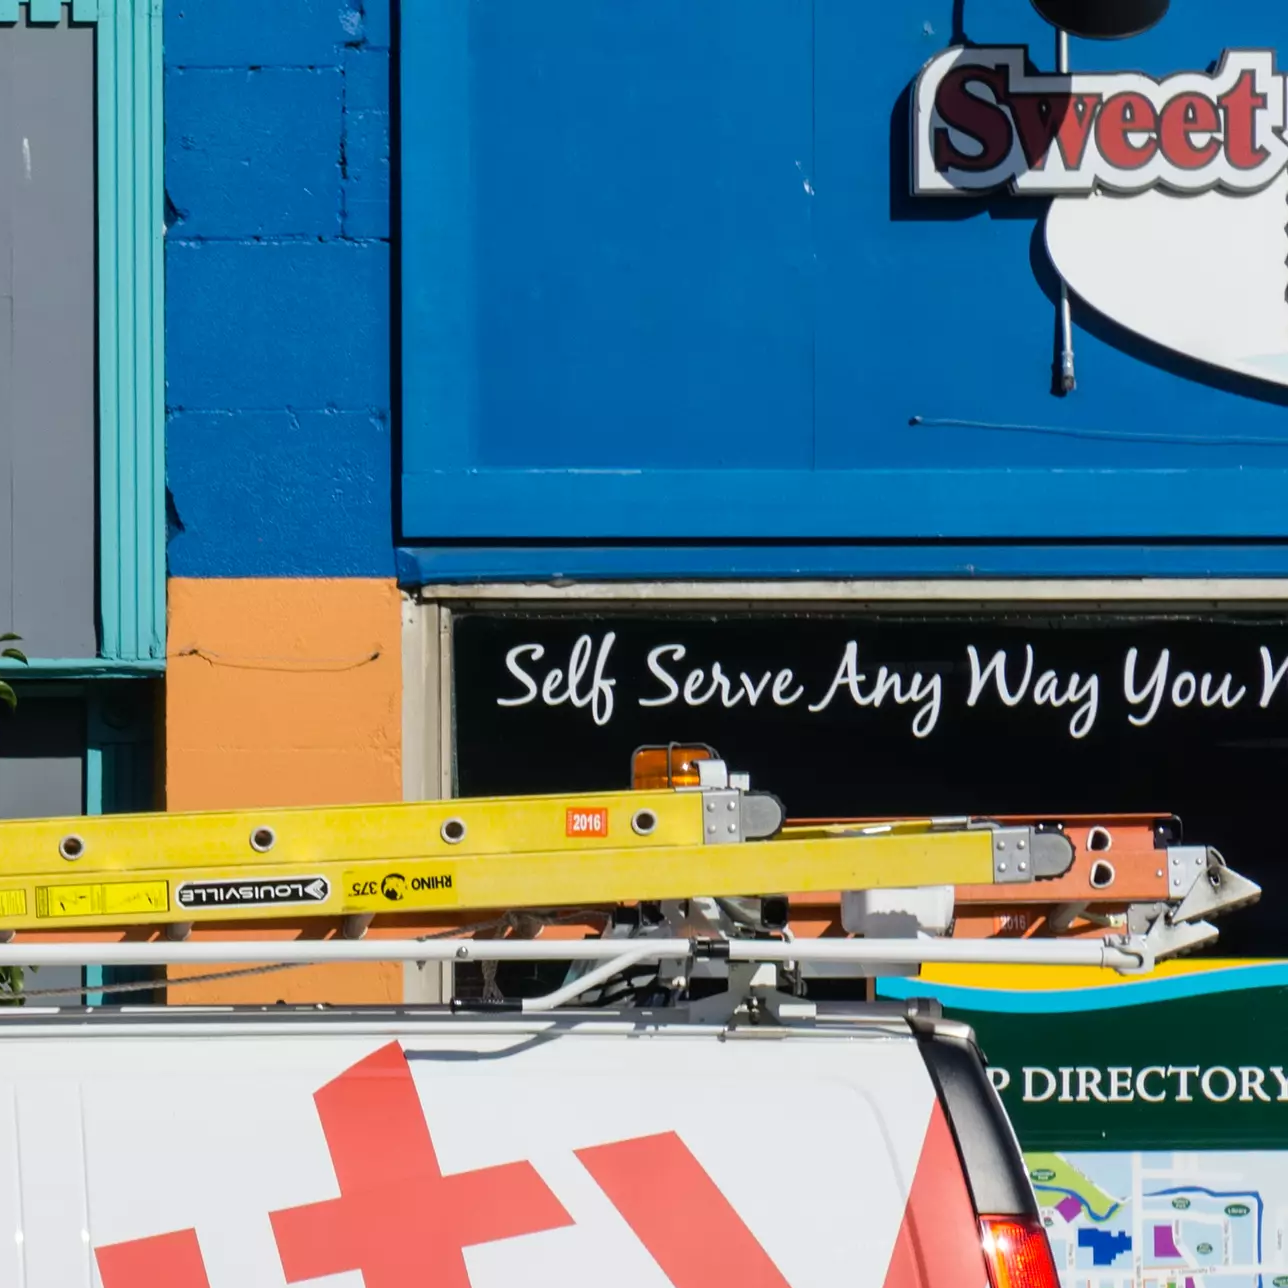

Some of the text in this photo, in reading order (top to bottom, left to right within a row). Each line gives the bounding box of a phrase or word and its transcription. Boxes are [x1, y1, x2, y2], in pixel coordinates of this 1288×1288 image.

[934, 64, 1272, 172] Sweet
[497, 631, 616, 726] Self
[638, 643, 804, 708] Serve
[807, 640, 942, 738] Any
[966, 644, 1099, 739] Way
[1124, 647, 1246, 726] You
[573, 813, 601, 831] 2016
[180, 884, 304, 902] LOUISVILLE
[352, 875, 452, 896] RHINO 375
[999, 914, 1027, 931] 2016
